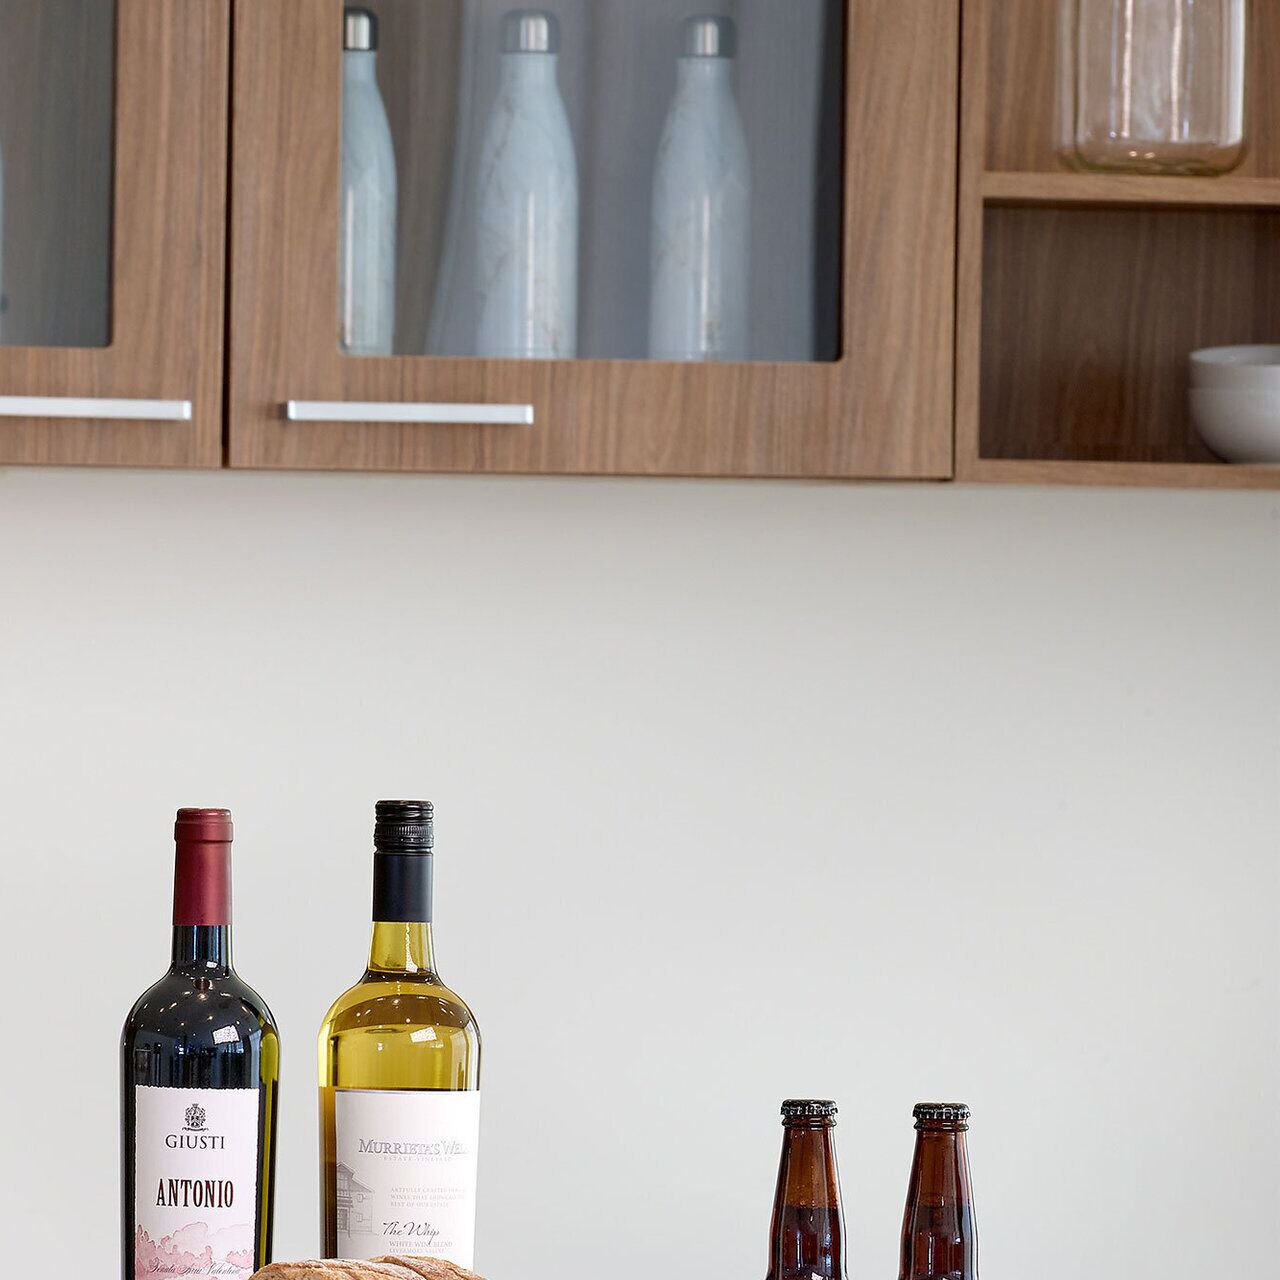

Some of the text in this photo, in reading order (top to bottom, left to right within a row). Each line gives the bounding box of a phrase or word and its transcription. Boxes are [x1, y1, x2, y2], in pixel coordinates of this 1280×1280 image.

[165, 1134, 225, 1150] GIUSTI
[358, 1138, 440, 1155] MURRIETA'S
[155, 1178, 234, 1208] ANTONIO
[383, 1221, 440, 1246] The Whip
